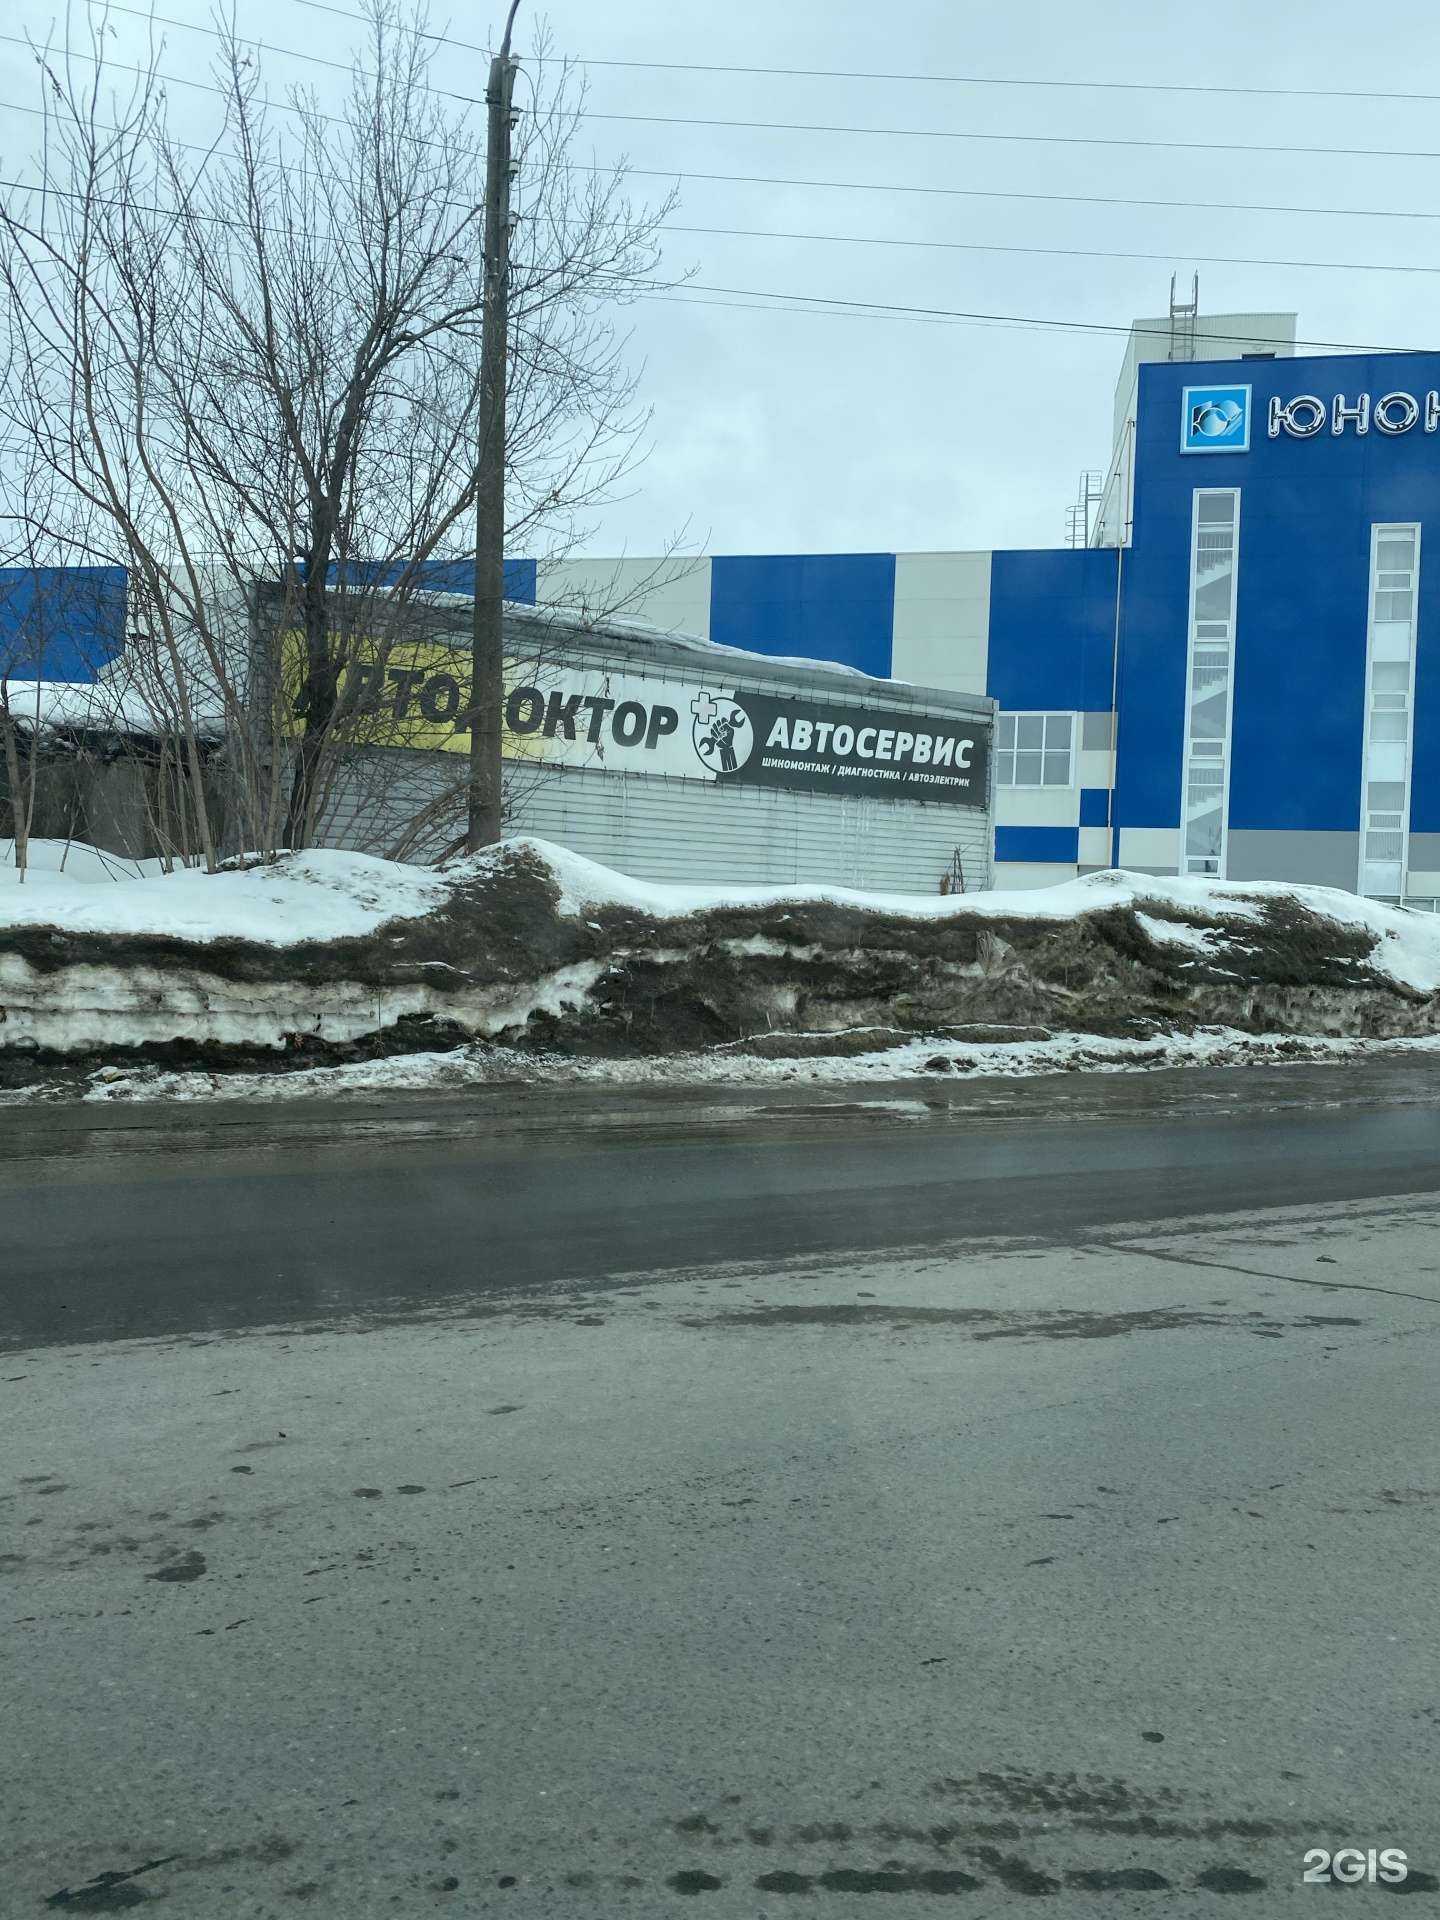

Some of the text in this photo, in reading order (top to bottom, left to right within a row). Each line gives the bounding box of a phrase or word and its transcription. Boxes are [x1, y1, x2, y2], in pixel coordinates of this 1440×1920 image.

[292, 660, 679, 750] ВТООКТОР
[765, 716, 975, 769] АВТОСЕРВИС
[761, 757, 830, 774] ШИНОМОНТАЖ
[837, 766, 901, 780] ДИАГНОСТИКА
[908, 772, 970, 787] АВТОЭЛЕКТРИК
